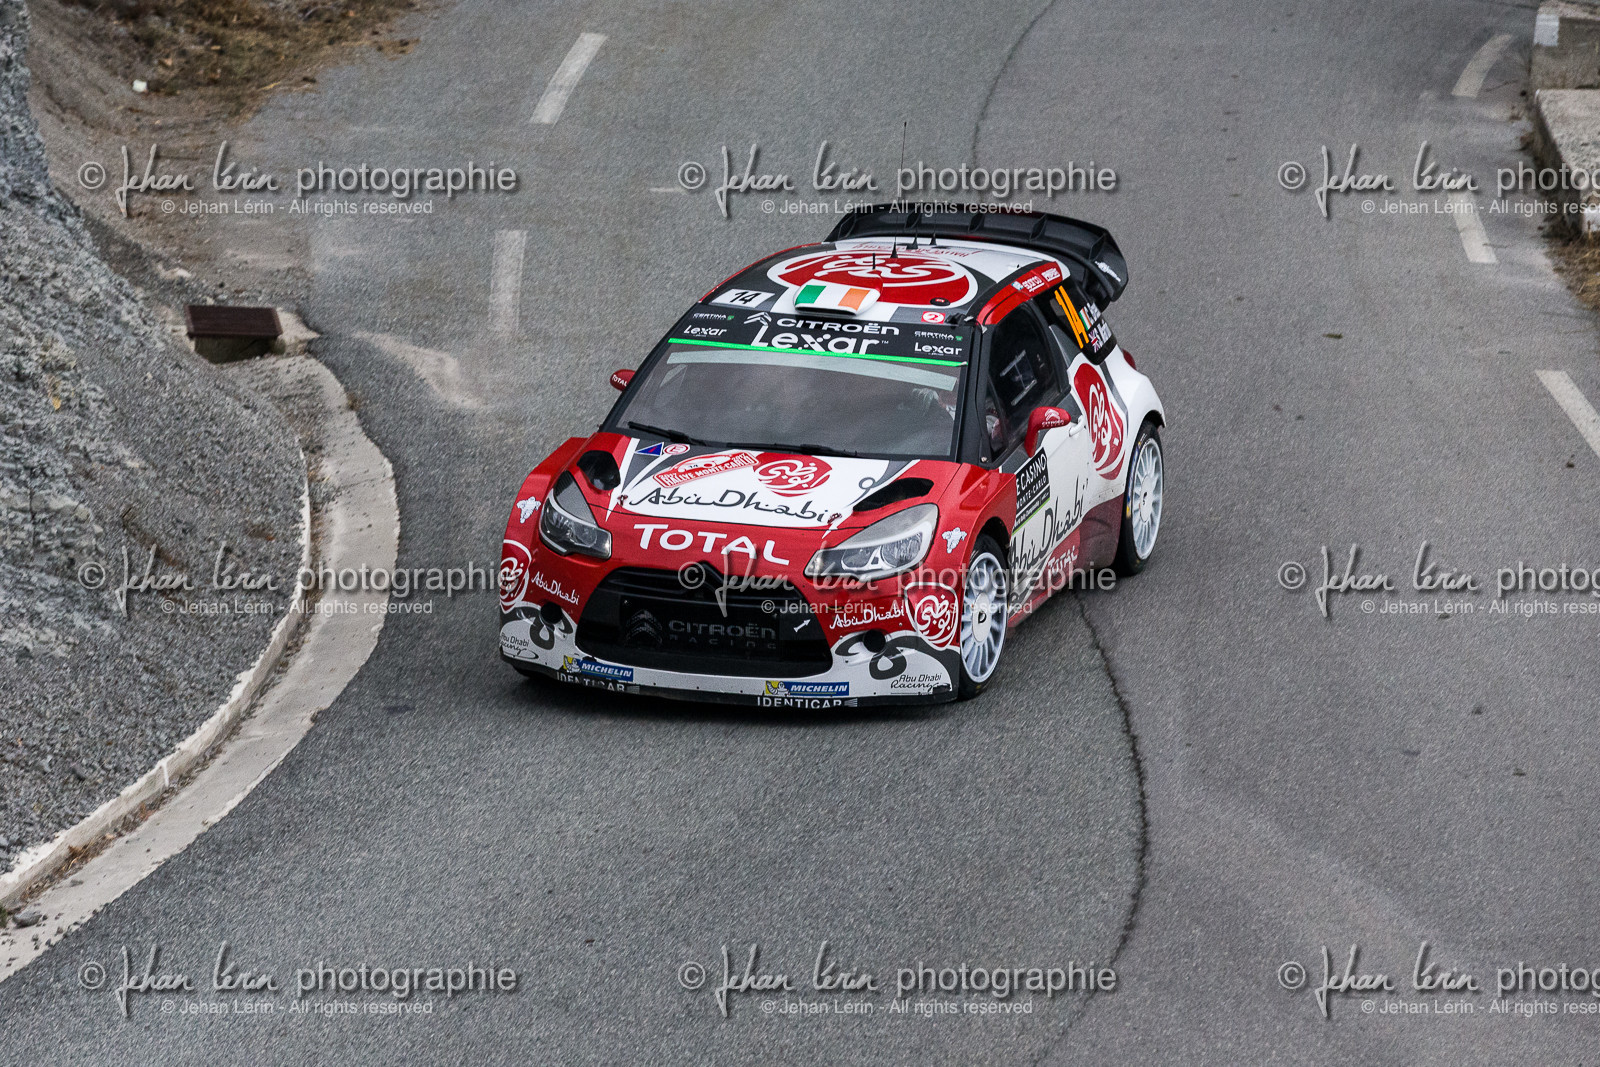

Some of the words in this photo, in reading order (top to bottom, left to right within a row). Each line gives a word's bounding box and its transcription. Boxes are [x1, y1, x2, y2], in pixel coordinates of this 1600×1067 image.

[730, 292, 763, 304] 14
[1054, 285, 1090, 349] 14
[684, 325, 728, 336] Lexar
[776, 318, 900, 336] CITROËN
[750, 325, 880, 355] Lexar
[914, 342, 963, 355] Lexar
[1021, 453, 1047, 491] CASINO
[661, 473, 695, 487] RALLYE
[633, 523, 790, 566] TOTAL
[581, 662, 632, 677] MICHELIN
[899, 674, 917, 683] Abu
[917, 672, 943, 682] Dhabi
[790, 684, 848, 692] MICHELIN
[757, 696, 843, 709] IDENTICAR
